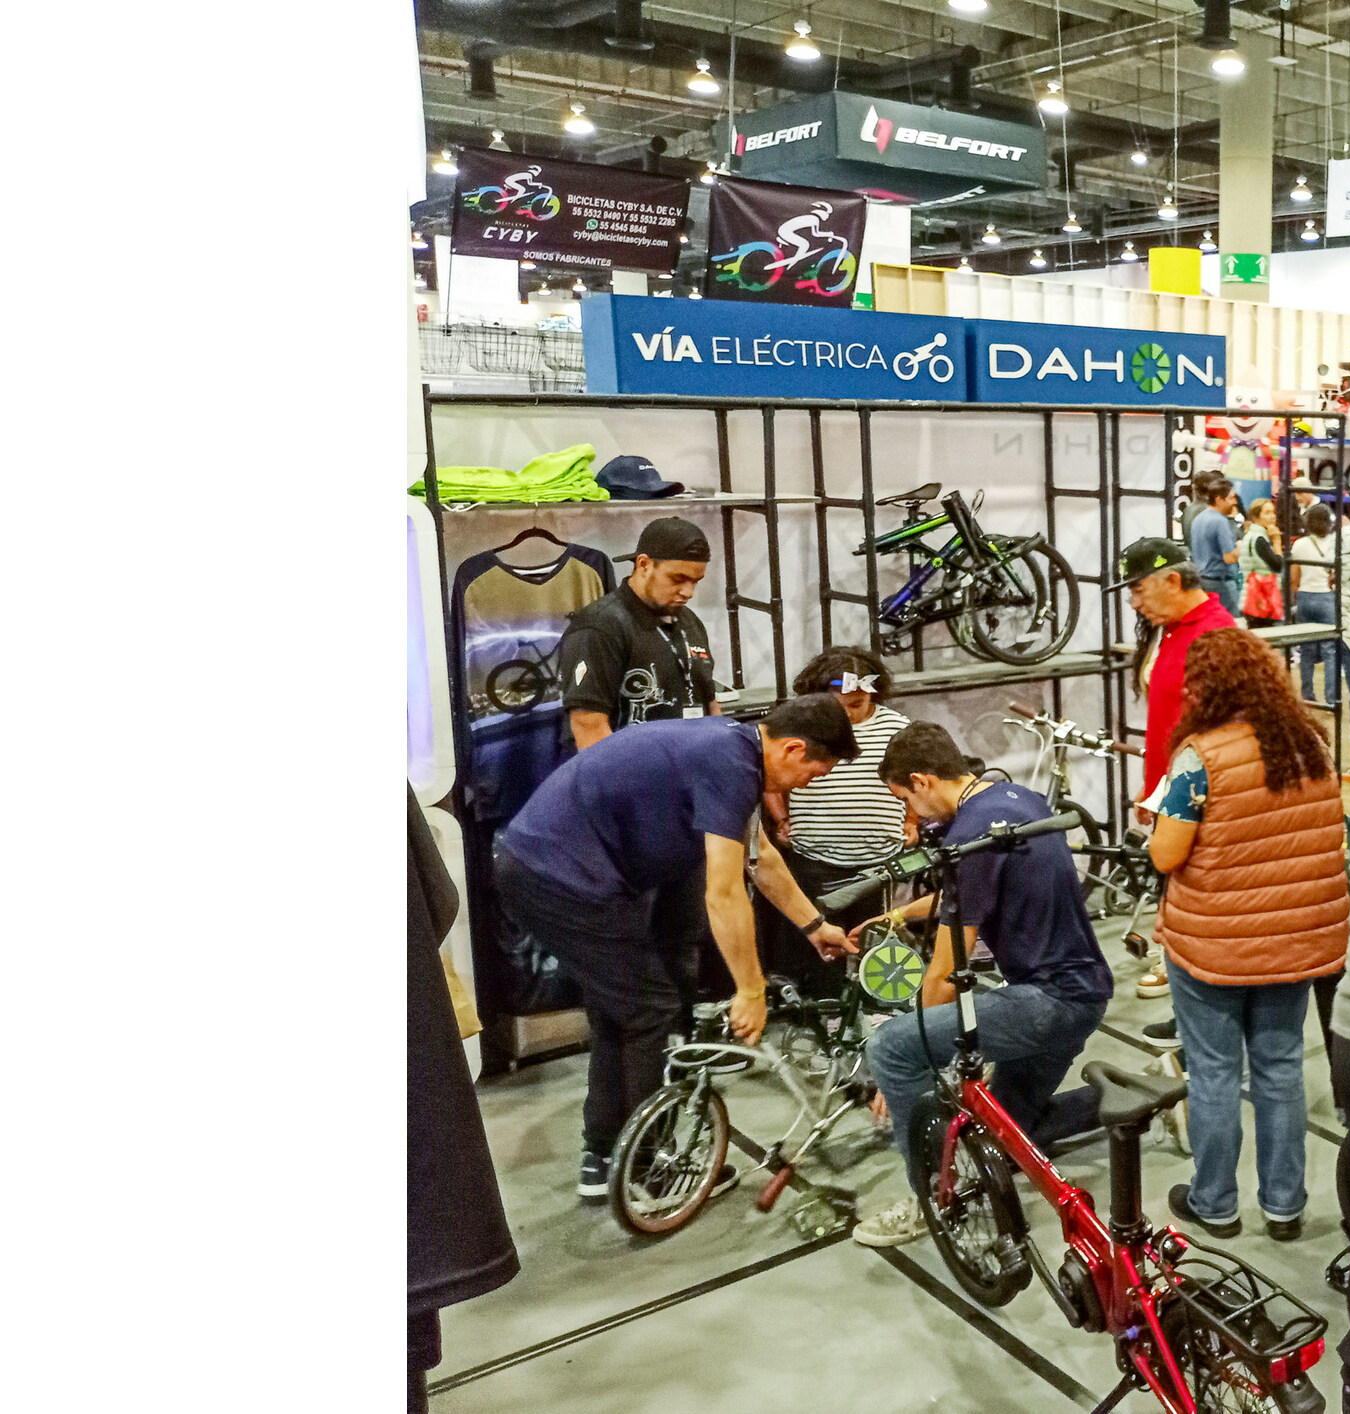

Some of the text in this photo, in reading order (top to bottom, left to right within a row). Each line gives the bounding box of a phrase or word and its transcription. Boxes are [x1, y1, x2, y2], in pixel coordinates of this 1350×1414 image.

[744, 120, 823, 151] BELFORT
[894, 127, 1028, 162] BELFORT
[567, 194, 683, 218] BICICLETAS CYBY S.A. DE C.V.
[572, 206, 583, 217] 55
[622, 212, 628, 222] Y
[629, 213, 639, 223] 55
[483, 226, 539, 244] CYBY
[599, 221, 609, 230] 55
[573, 229, 668, 248] cyby@bicicletascyby.com
[523, 250, 612, 267] SOMOS FABRICANTES
[631, 325, 888, 370] VÍA ELÉCTRICA
